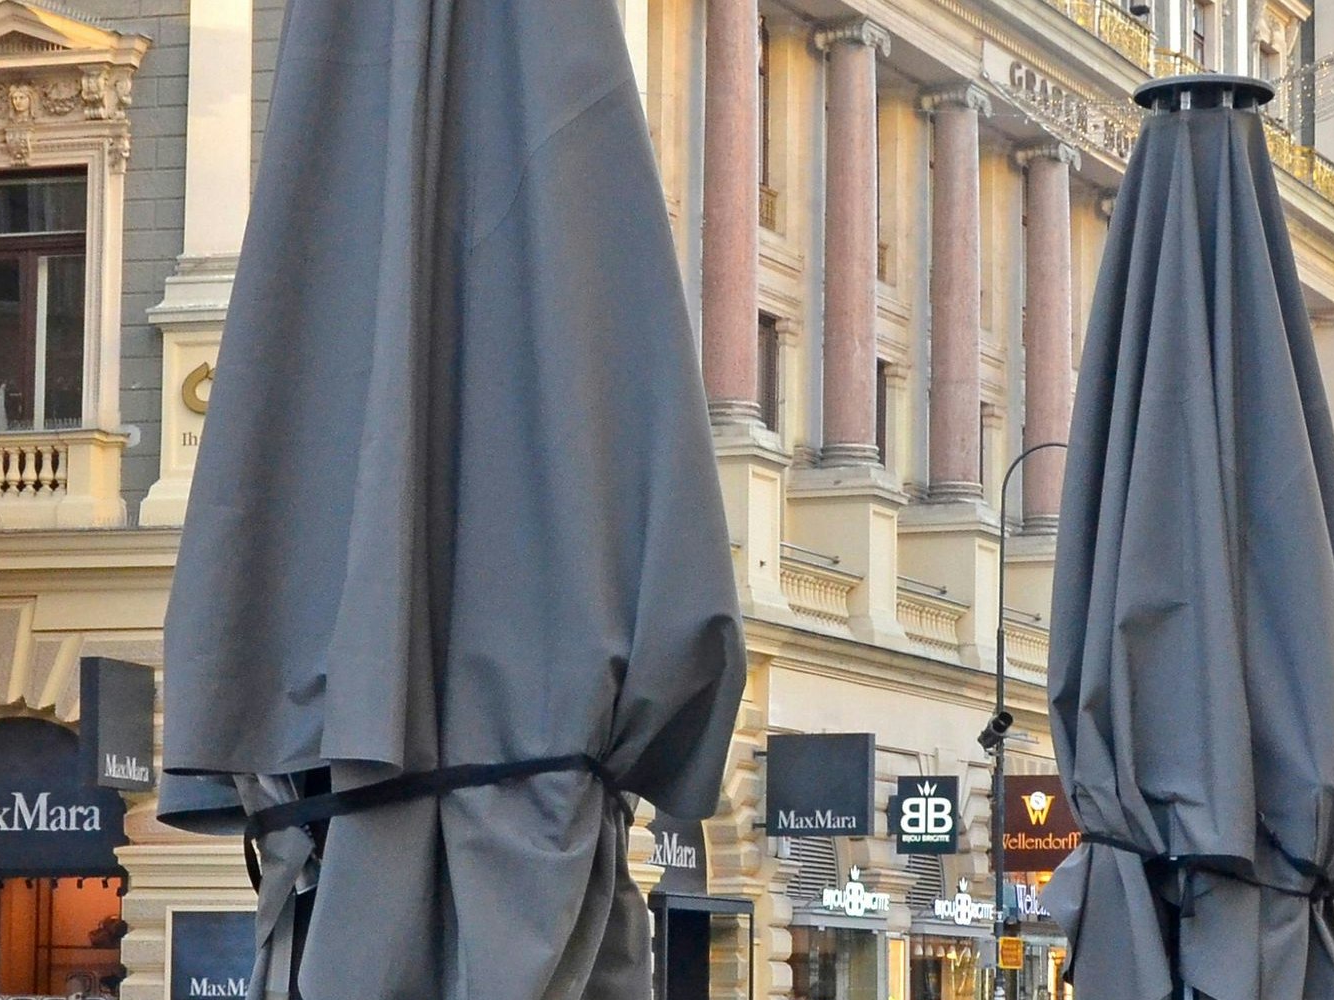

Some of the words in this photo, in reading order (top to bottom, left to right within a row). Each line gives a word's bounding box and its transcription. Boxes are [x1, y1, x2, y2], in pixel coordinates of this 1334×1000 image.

[104, 753, 150, 783] MaxMara
[777, 809, 857, 830] MaxMara
[646, 831, 697, 869] xMara
[189, 977, 250, 997] MaxM
